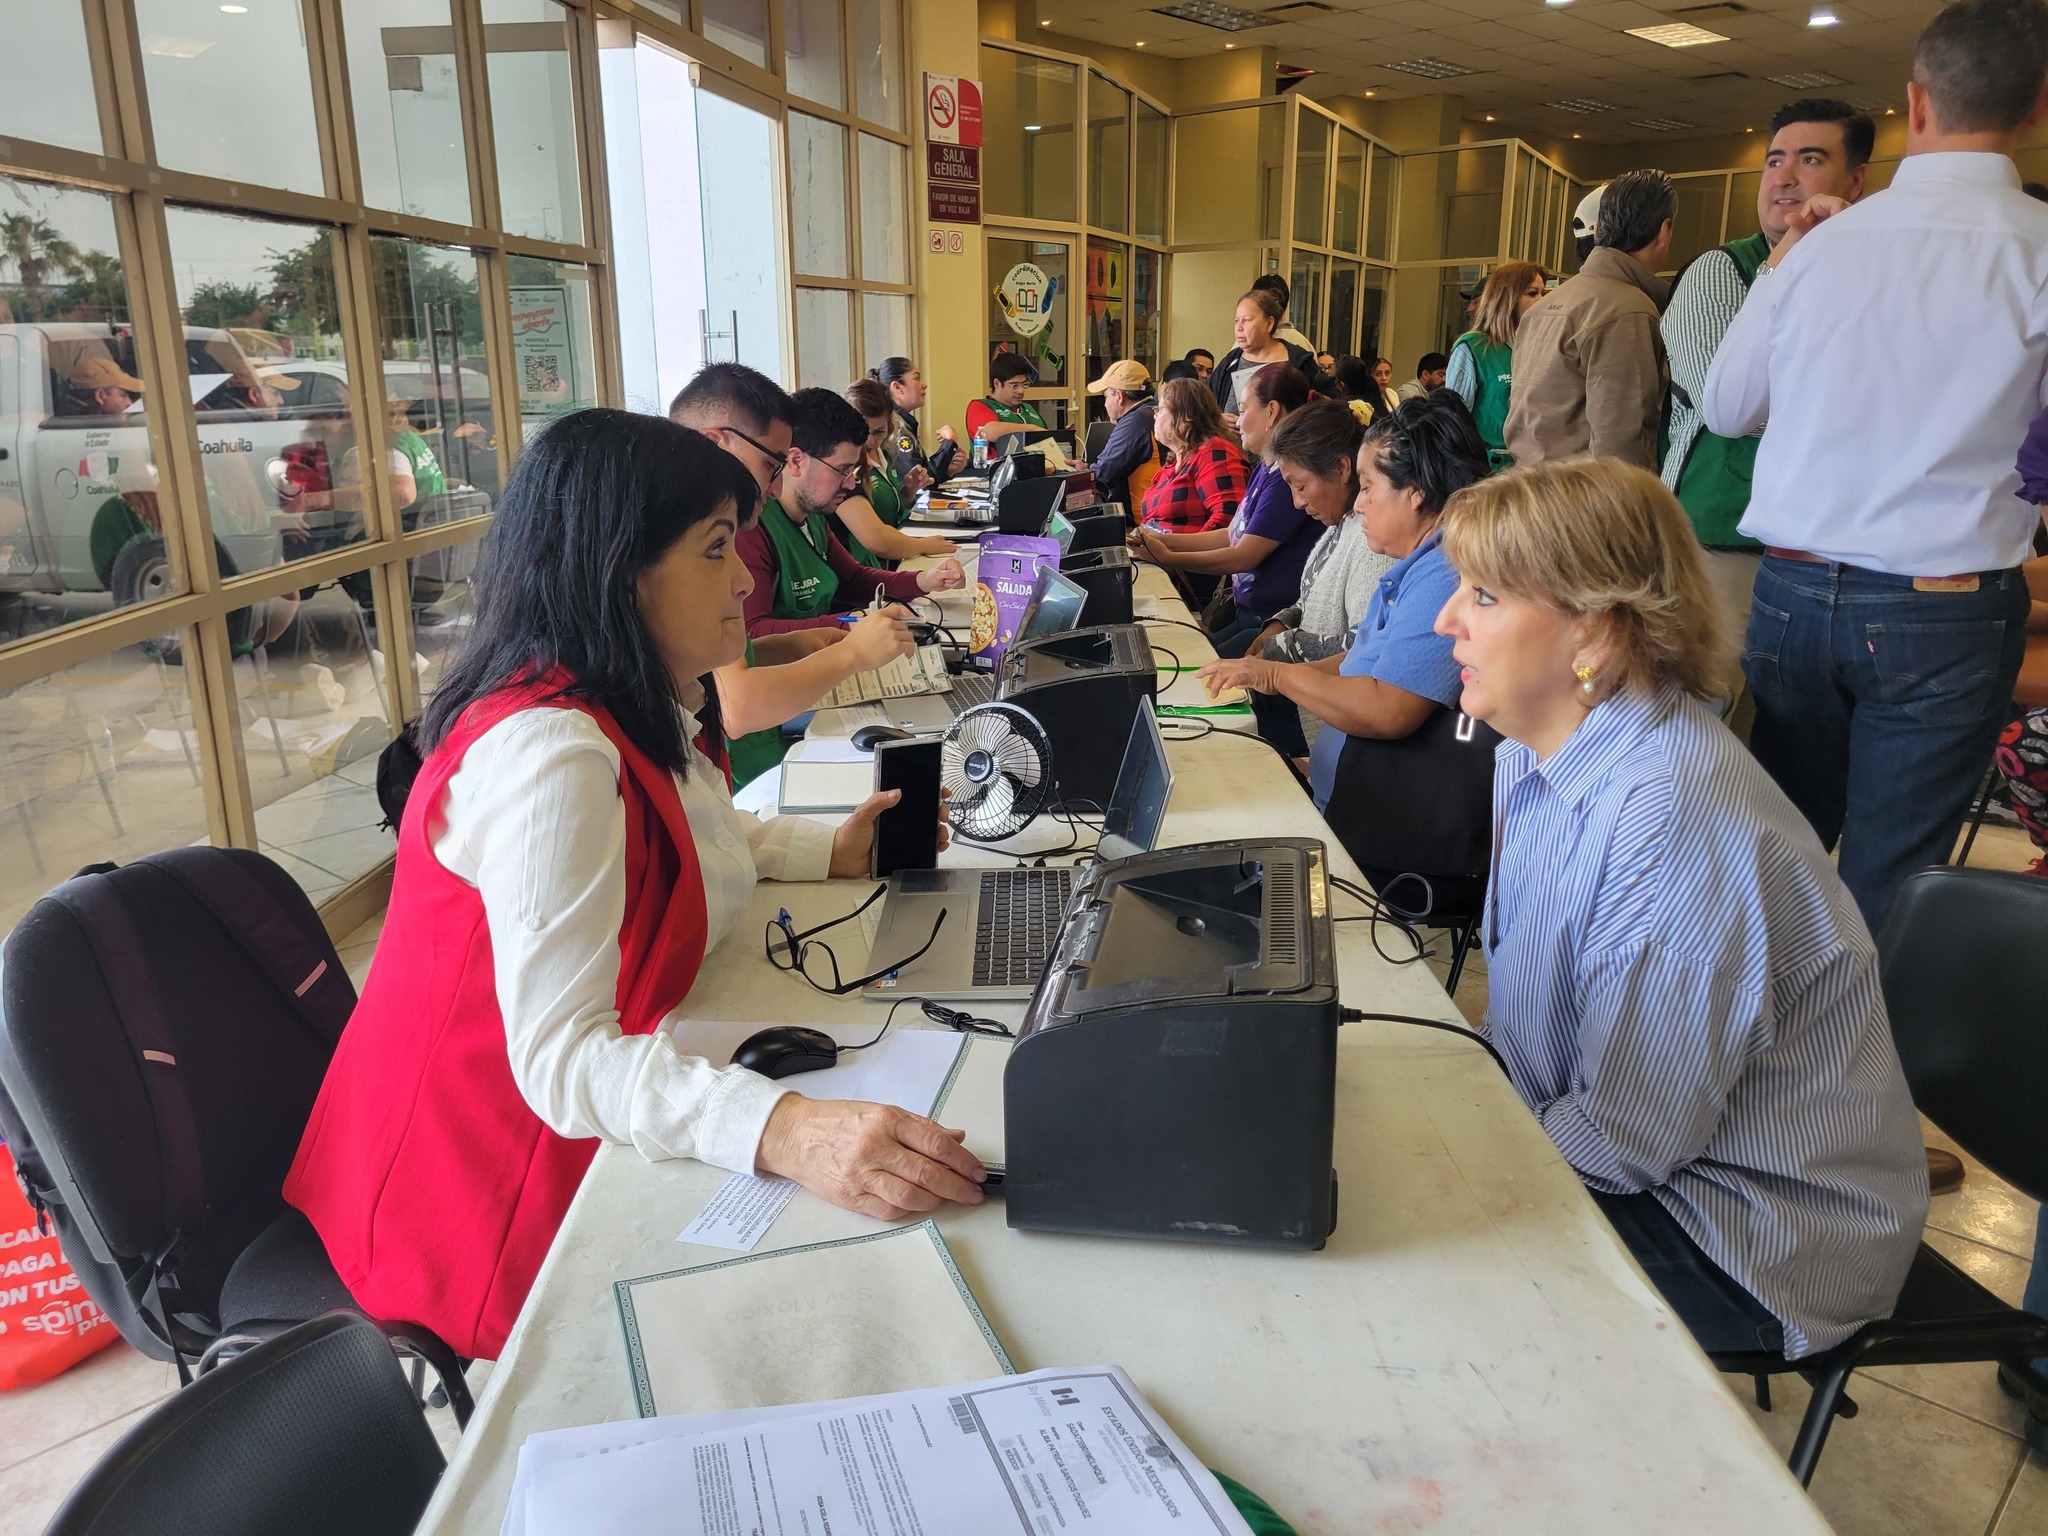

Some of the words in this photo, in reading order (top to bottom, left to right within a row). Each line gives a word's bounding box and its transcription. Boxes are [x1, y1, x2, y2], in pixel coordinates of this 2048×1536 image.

[943, 148, 965, 163] SALA
[934, 162, 973, 178] GENERAL
[932, 193, 949, 201] FAVOR
[950, 194, 957, 202] DE
[958, 195, 976, 204] HABLAR
[940, 204, 946, 212] EN
[948, 205, 957, 213] VOZ
[959, 206, 970, 214] BAJA
[32, 1273, 81, 1299] TUS
[22, 1300, 97, 1335] spin
[1049, 1442, 1063, 1469] PATRICIA
[1060, 1465, 1078, 1493] SANTOS
[1101, 1406, 1126, 1436] ESTADOS
[1123, 1432, 1148, 1465] UNIDOS
[1142, 1464, 1181, 1519] MEXICANOS
